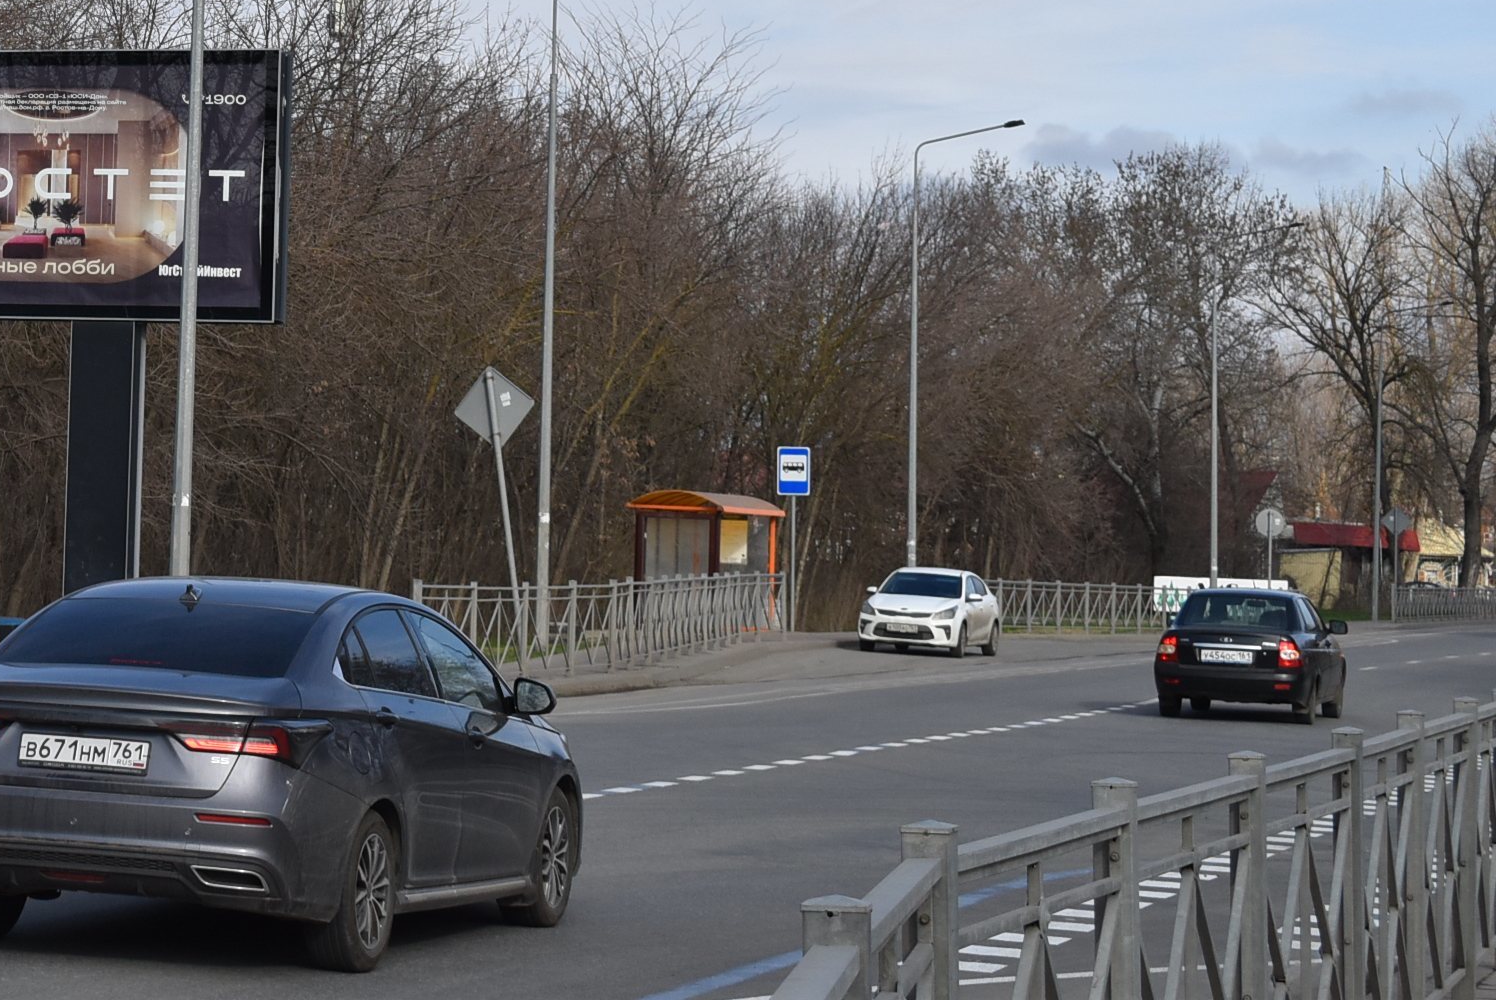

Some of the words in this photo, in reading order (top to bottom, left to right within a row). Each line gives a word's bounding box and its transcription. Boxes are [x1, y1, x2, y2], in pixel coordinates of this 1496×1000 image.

[43, 258, 115, 275] лобби
[158, 264, 242, 279] ЮгСтйИнвест
[26, 738, 107, 763] В671НМ
[112, 742, 144, 761] 761
[116, 759, 133, 767] RUS
